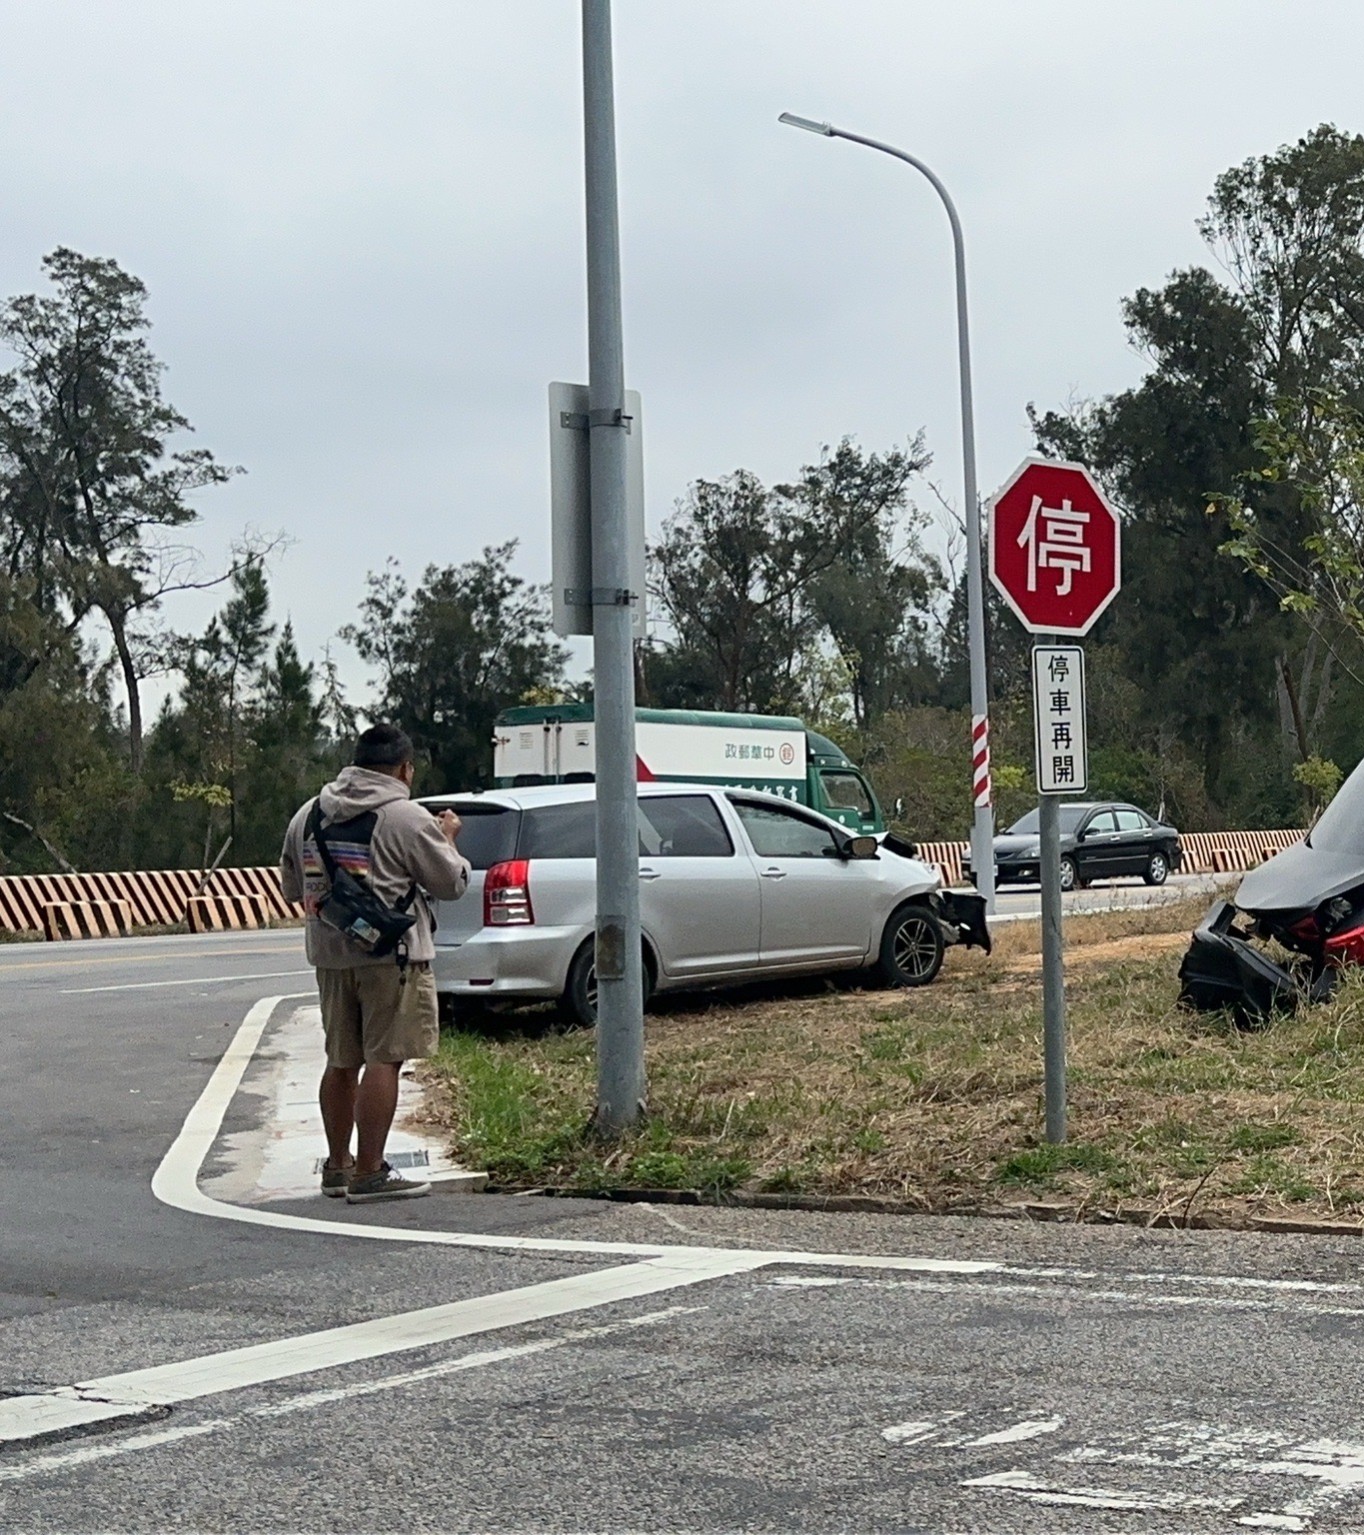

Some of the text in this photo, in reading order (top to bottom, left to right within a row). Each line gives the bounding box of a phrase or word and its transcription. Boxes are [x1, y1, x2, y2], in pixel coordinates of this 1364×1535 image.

[1017, 495, 1091, 595] 停
[1048, 655, 1074, 783] 停車再開
